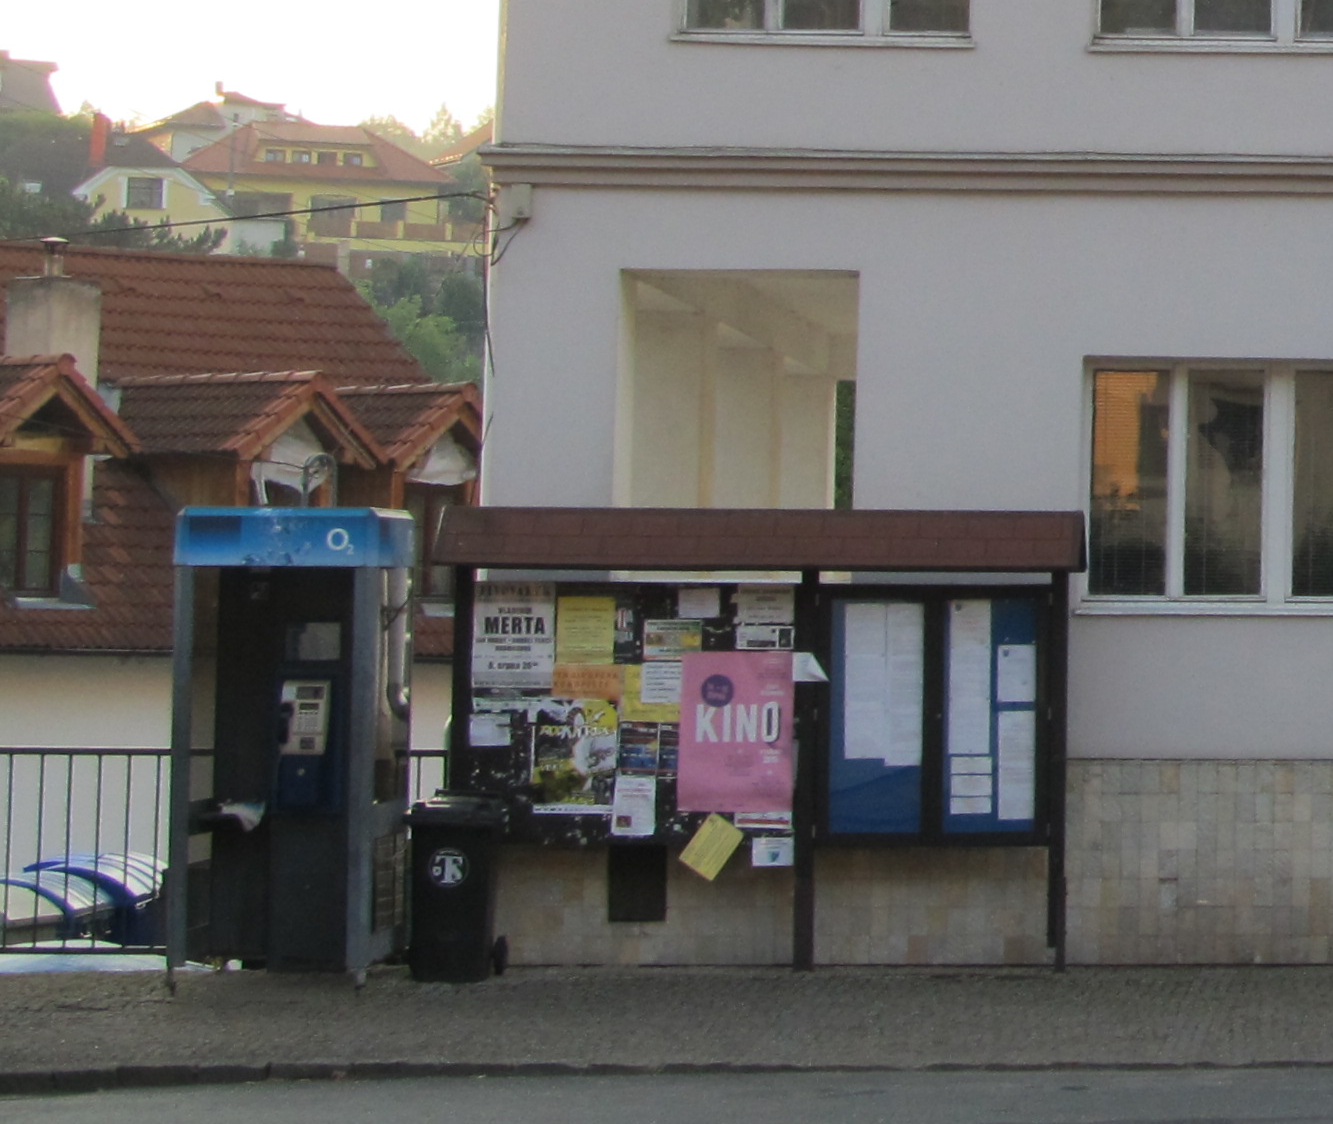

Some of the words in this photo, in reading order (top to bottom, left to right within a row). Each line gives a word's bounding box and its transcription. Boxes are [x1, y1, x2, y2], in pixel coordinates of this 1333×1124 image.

[326, 528, 355, 555] O2
[484, 617, 545, 634] MERTA
[695, 701, 780, 744] KINO
